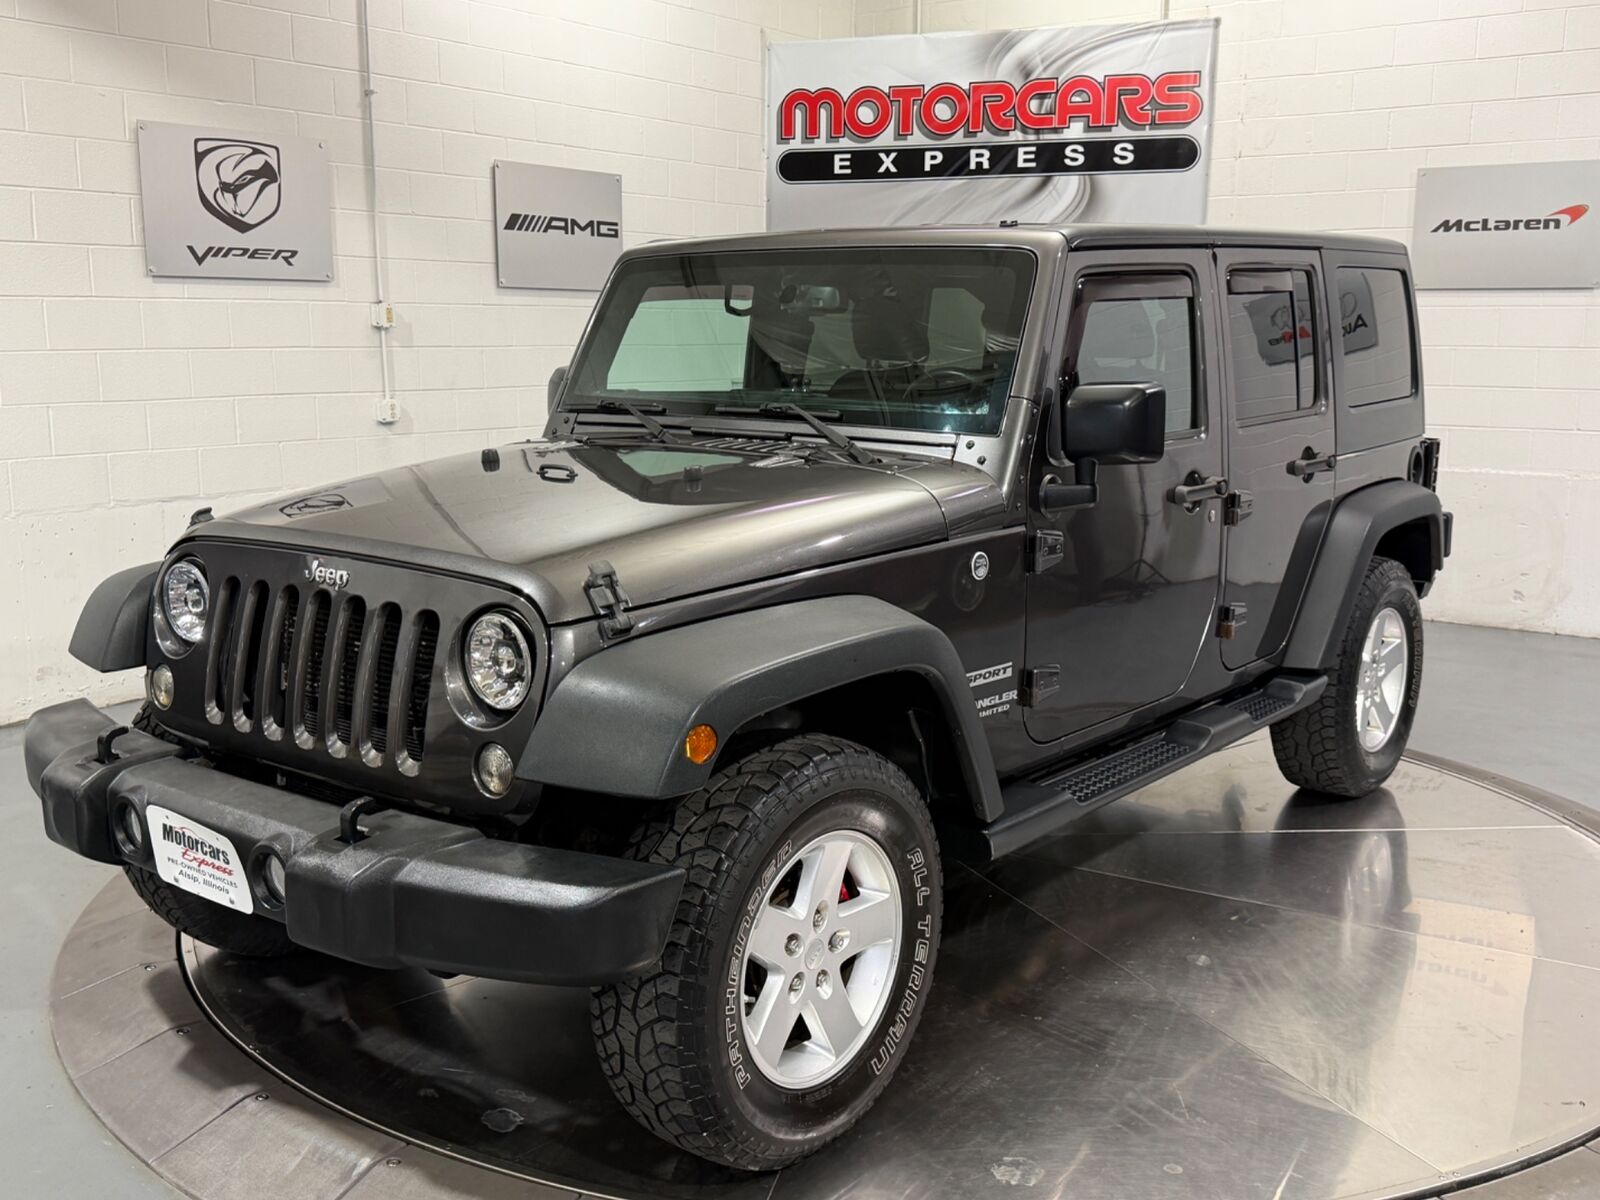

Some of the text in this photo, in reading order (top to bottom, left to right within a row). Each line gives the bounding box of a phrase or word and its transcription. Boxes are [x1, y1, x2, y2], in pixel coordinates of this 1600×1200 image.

[779, 71, 1204, 141] MOTORCARS
[833, 142, 1136, 174] EXPRESS
[543, 216, 619, 238] AMG
[1430, 216, 1561, 233] McLaren
[186, 244, 299, 267] VIPER
[304, 560, 350, 590] Jeep
[976, 690, 1018, 709] NGLER
[162, 823, 230, 865] Motorcars
[181, 848, 234, 876] Express
[178, 869, 230, 894] Alsip, Illinois
[870, 848, 932, 1075] ALL TERRAIN
